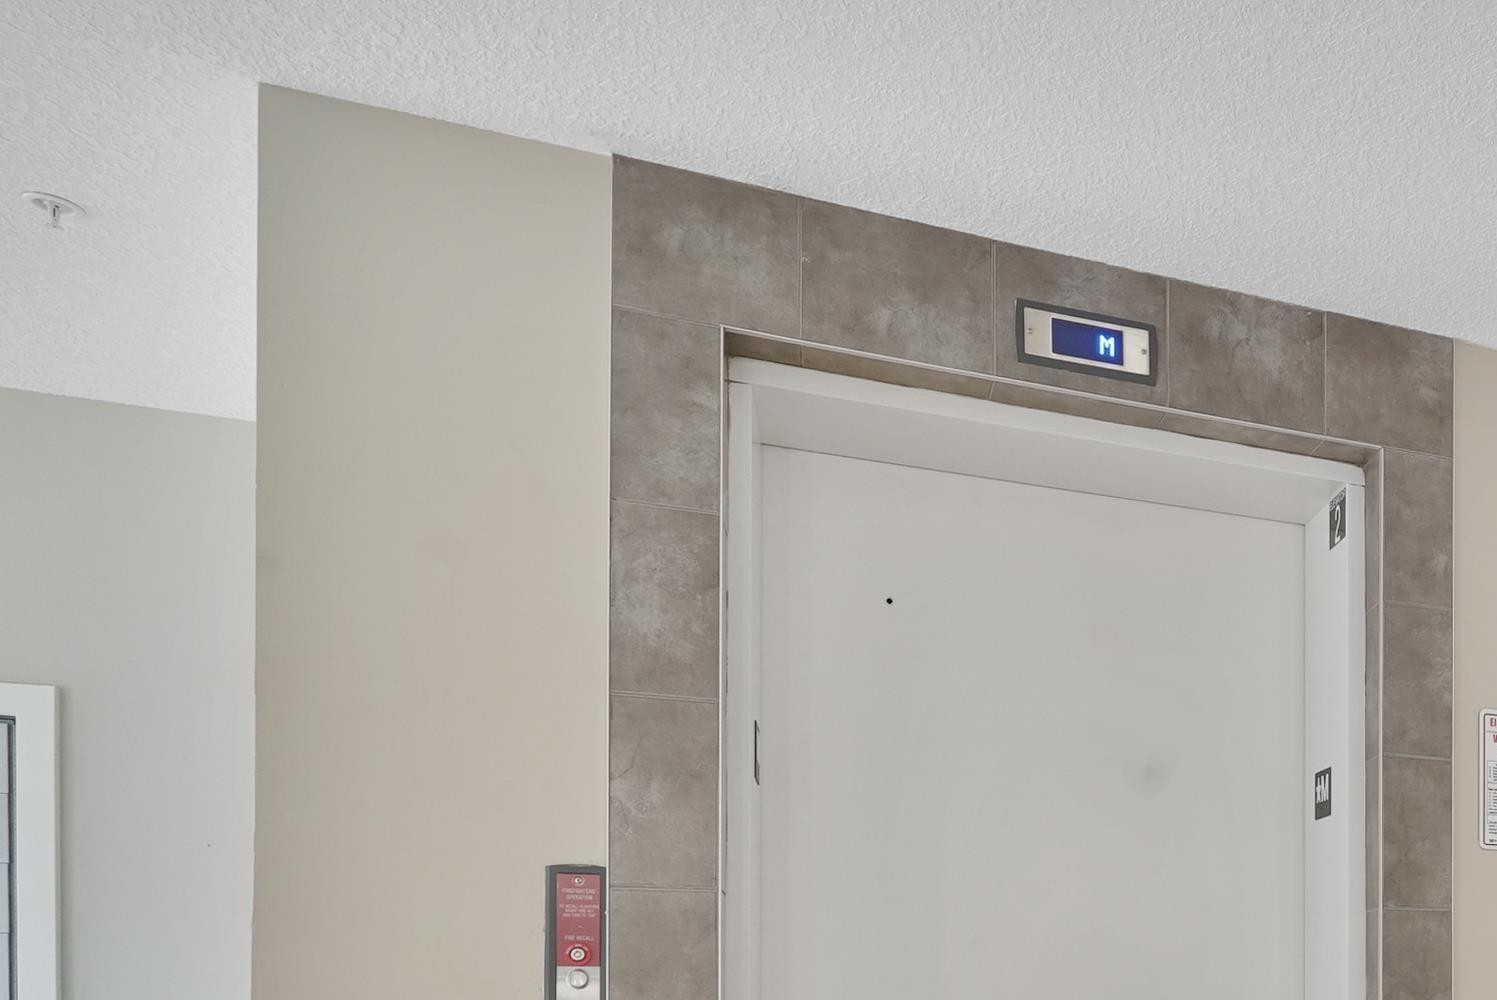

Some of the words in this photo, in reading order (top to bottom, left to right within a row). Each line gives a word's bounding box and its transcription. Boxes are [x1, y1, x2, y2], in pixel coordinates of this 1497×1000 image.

[1100, 335, 1115, 357] M
[1334, 504, 1342, 545] 2
[1320, 773, 1329, 802] M
